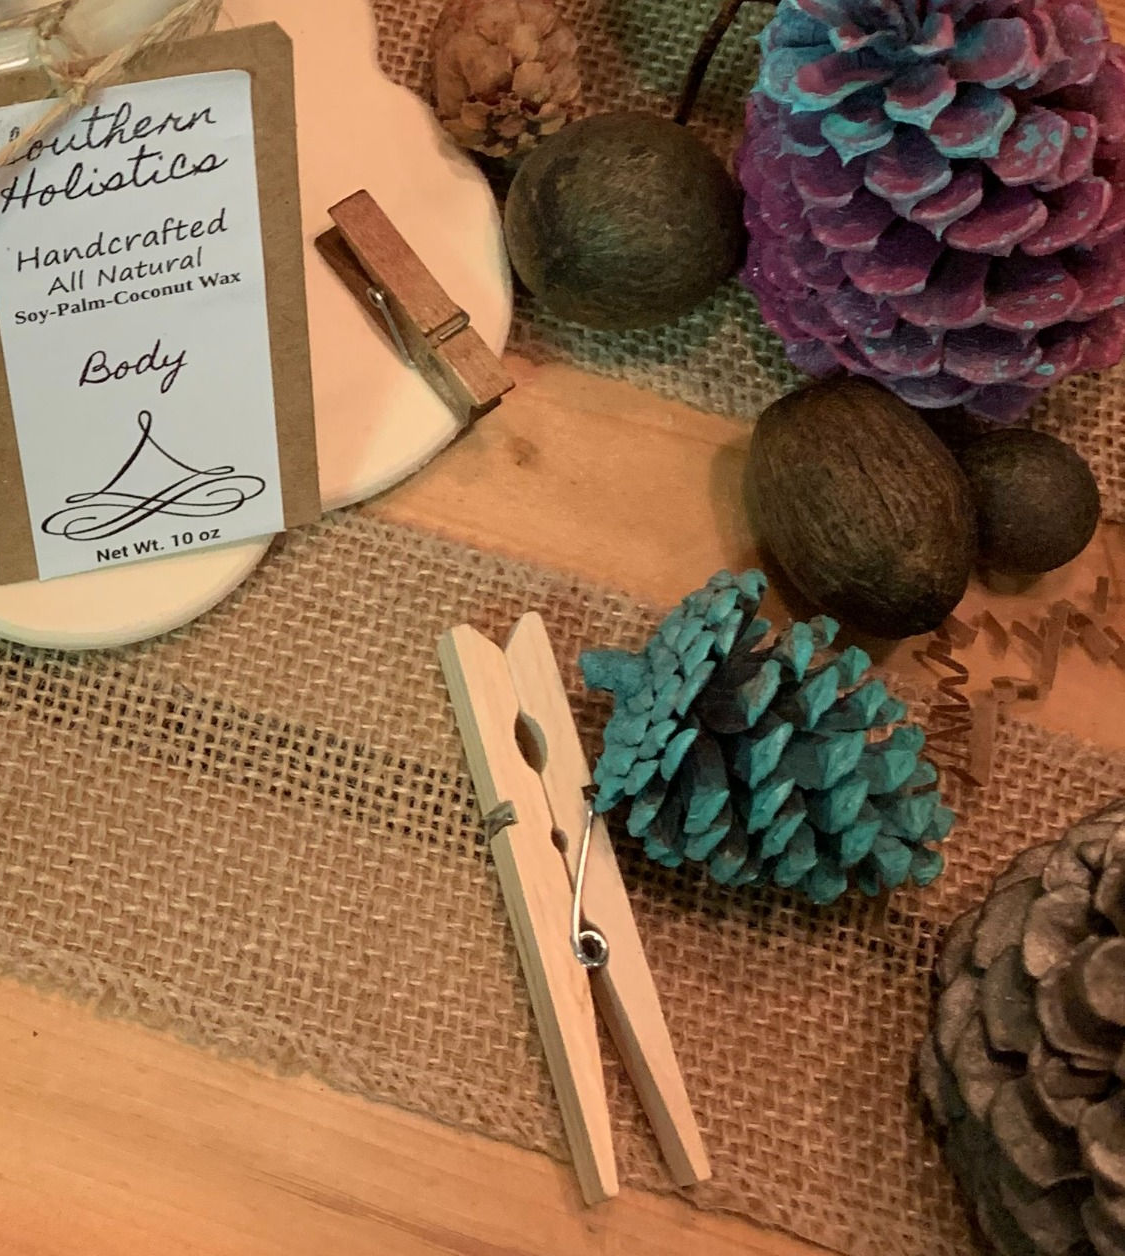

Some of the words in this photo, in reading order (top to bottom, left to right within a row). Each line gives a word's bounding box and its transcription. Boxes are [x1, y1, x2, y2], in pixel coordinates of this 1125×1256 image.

[0, 144, 229, 214] Holistics
[17, 207, 228, 272] Handcrafted
[13, 280, 194, 325] Soy-Palm-Coconut
[200, 271, 242, 288] Wax
[47, 271, 85, 296] All
[97, 246, 203, 287] Natural
[79, 339, 188, 394] Body
[96, 545, 129, 562] Net
[133, 537, 166, 555] Wt.
[171, 530, 194, 548] 10
[199, 528, 222, 542] oz
